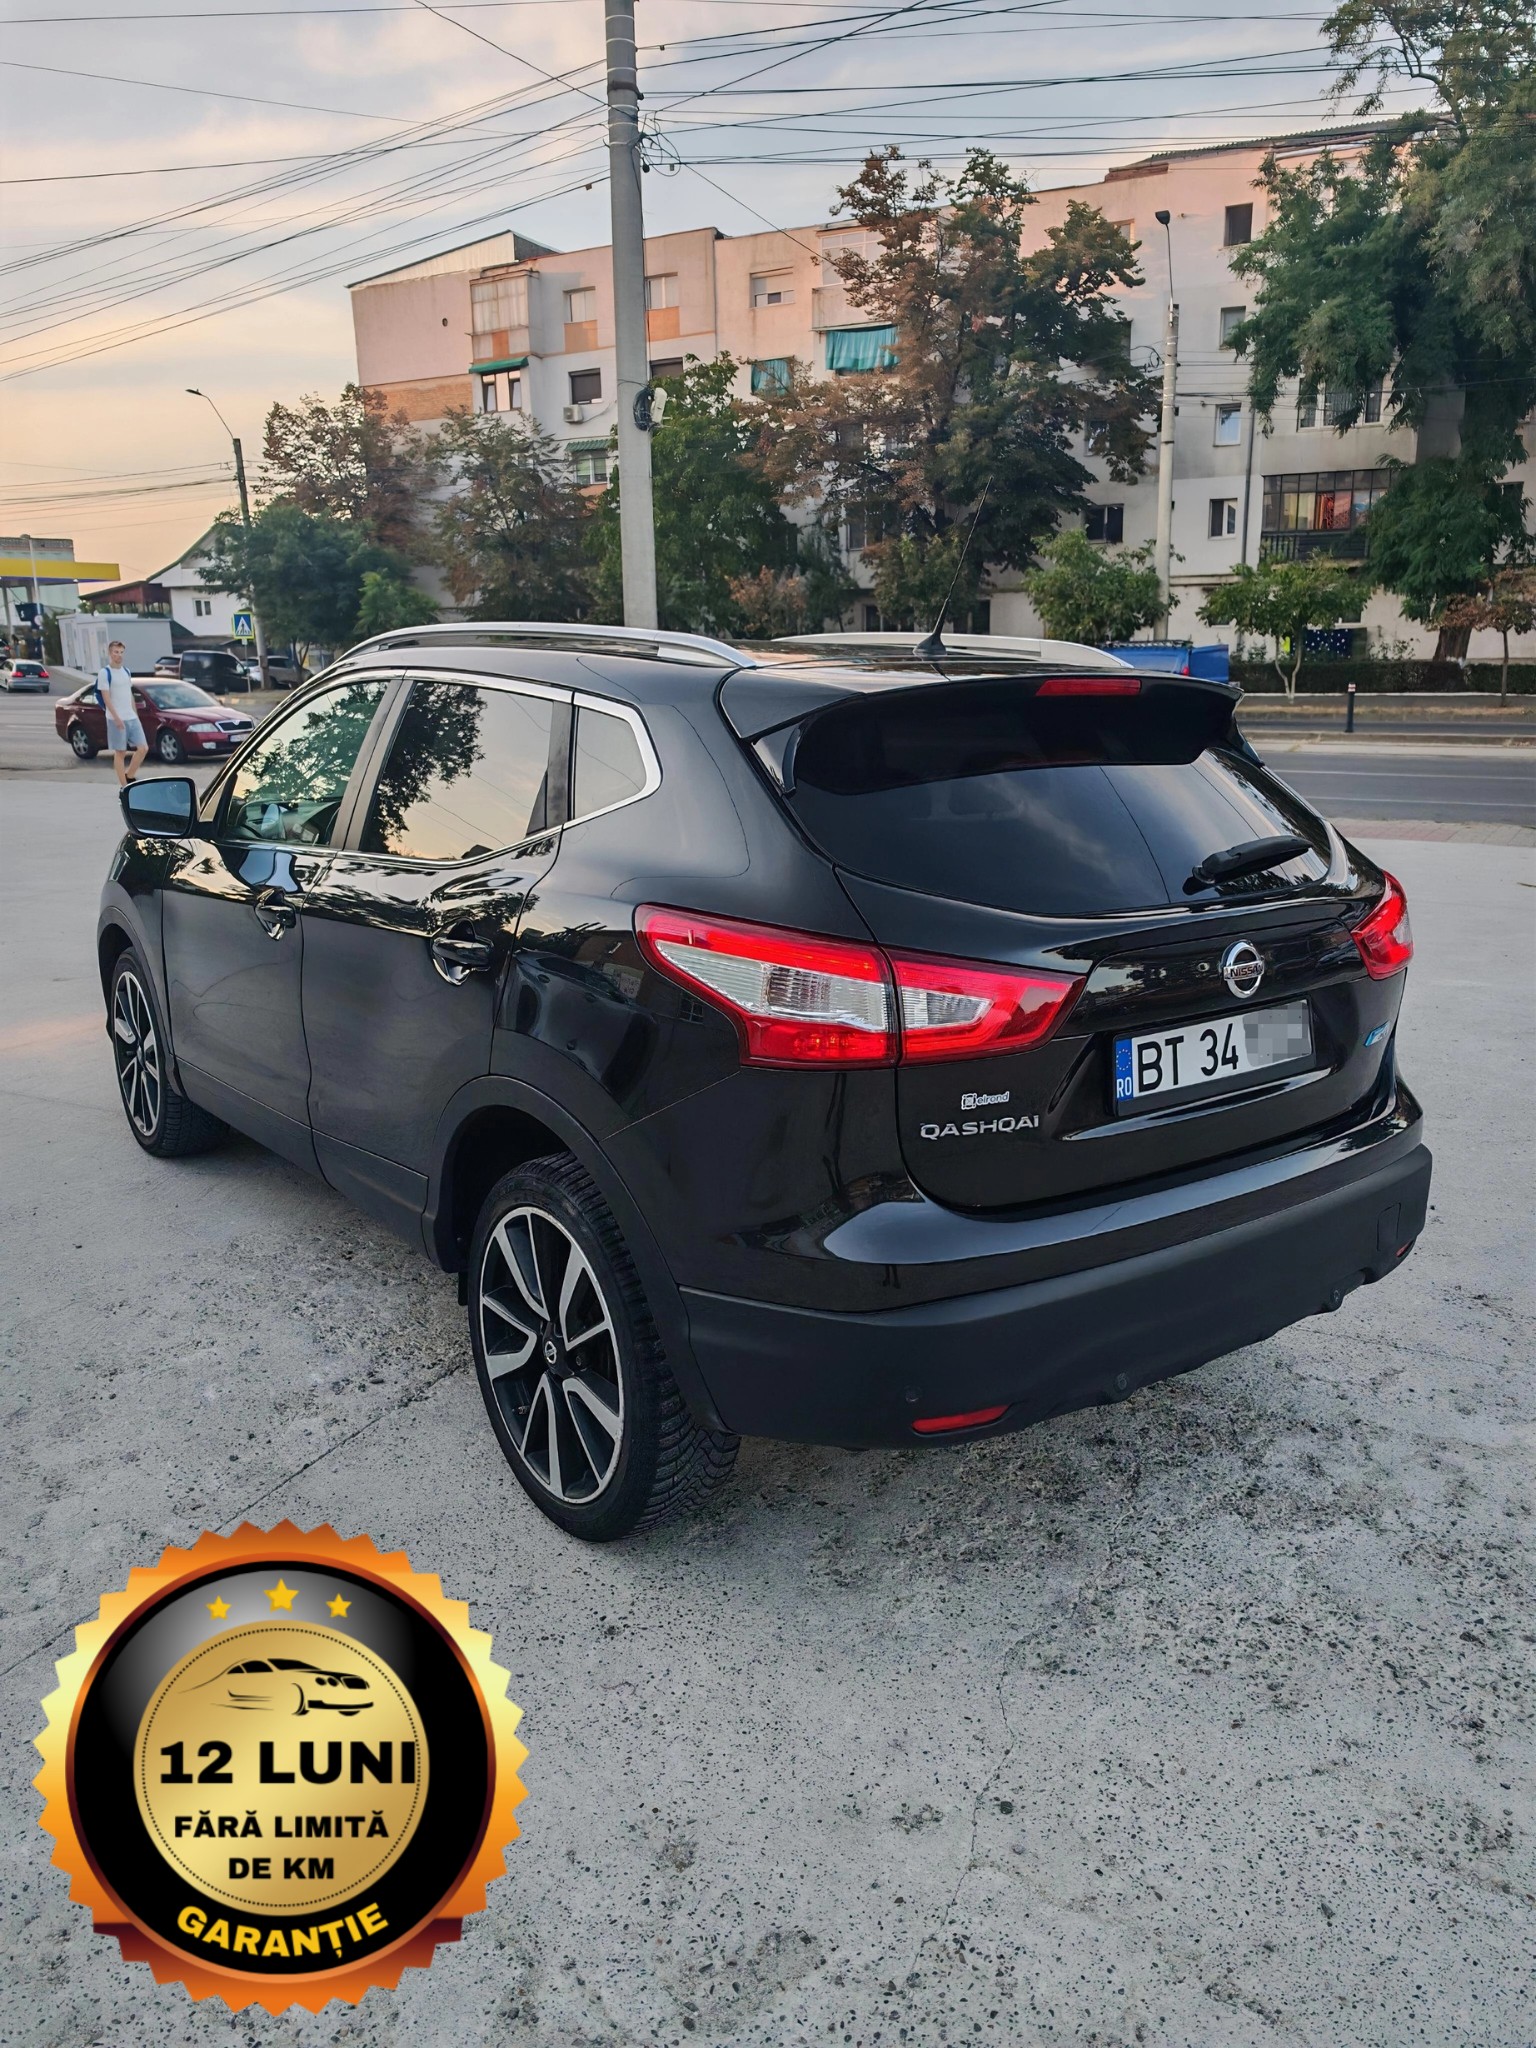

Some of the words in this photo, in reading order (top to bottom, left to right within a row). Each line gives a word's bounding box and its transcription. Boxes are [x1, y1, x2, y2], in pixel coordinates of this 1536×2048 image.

[1137, 1035, 1184, 1093] BT
[1199, 1023, 1239, 1077] 34
[1116, 1076, 1132, 1098] RO
[920, 1115, 1039, 1140] QASHQAI
